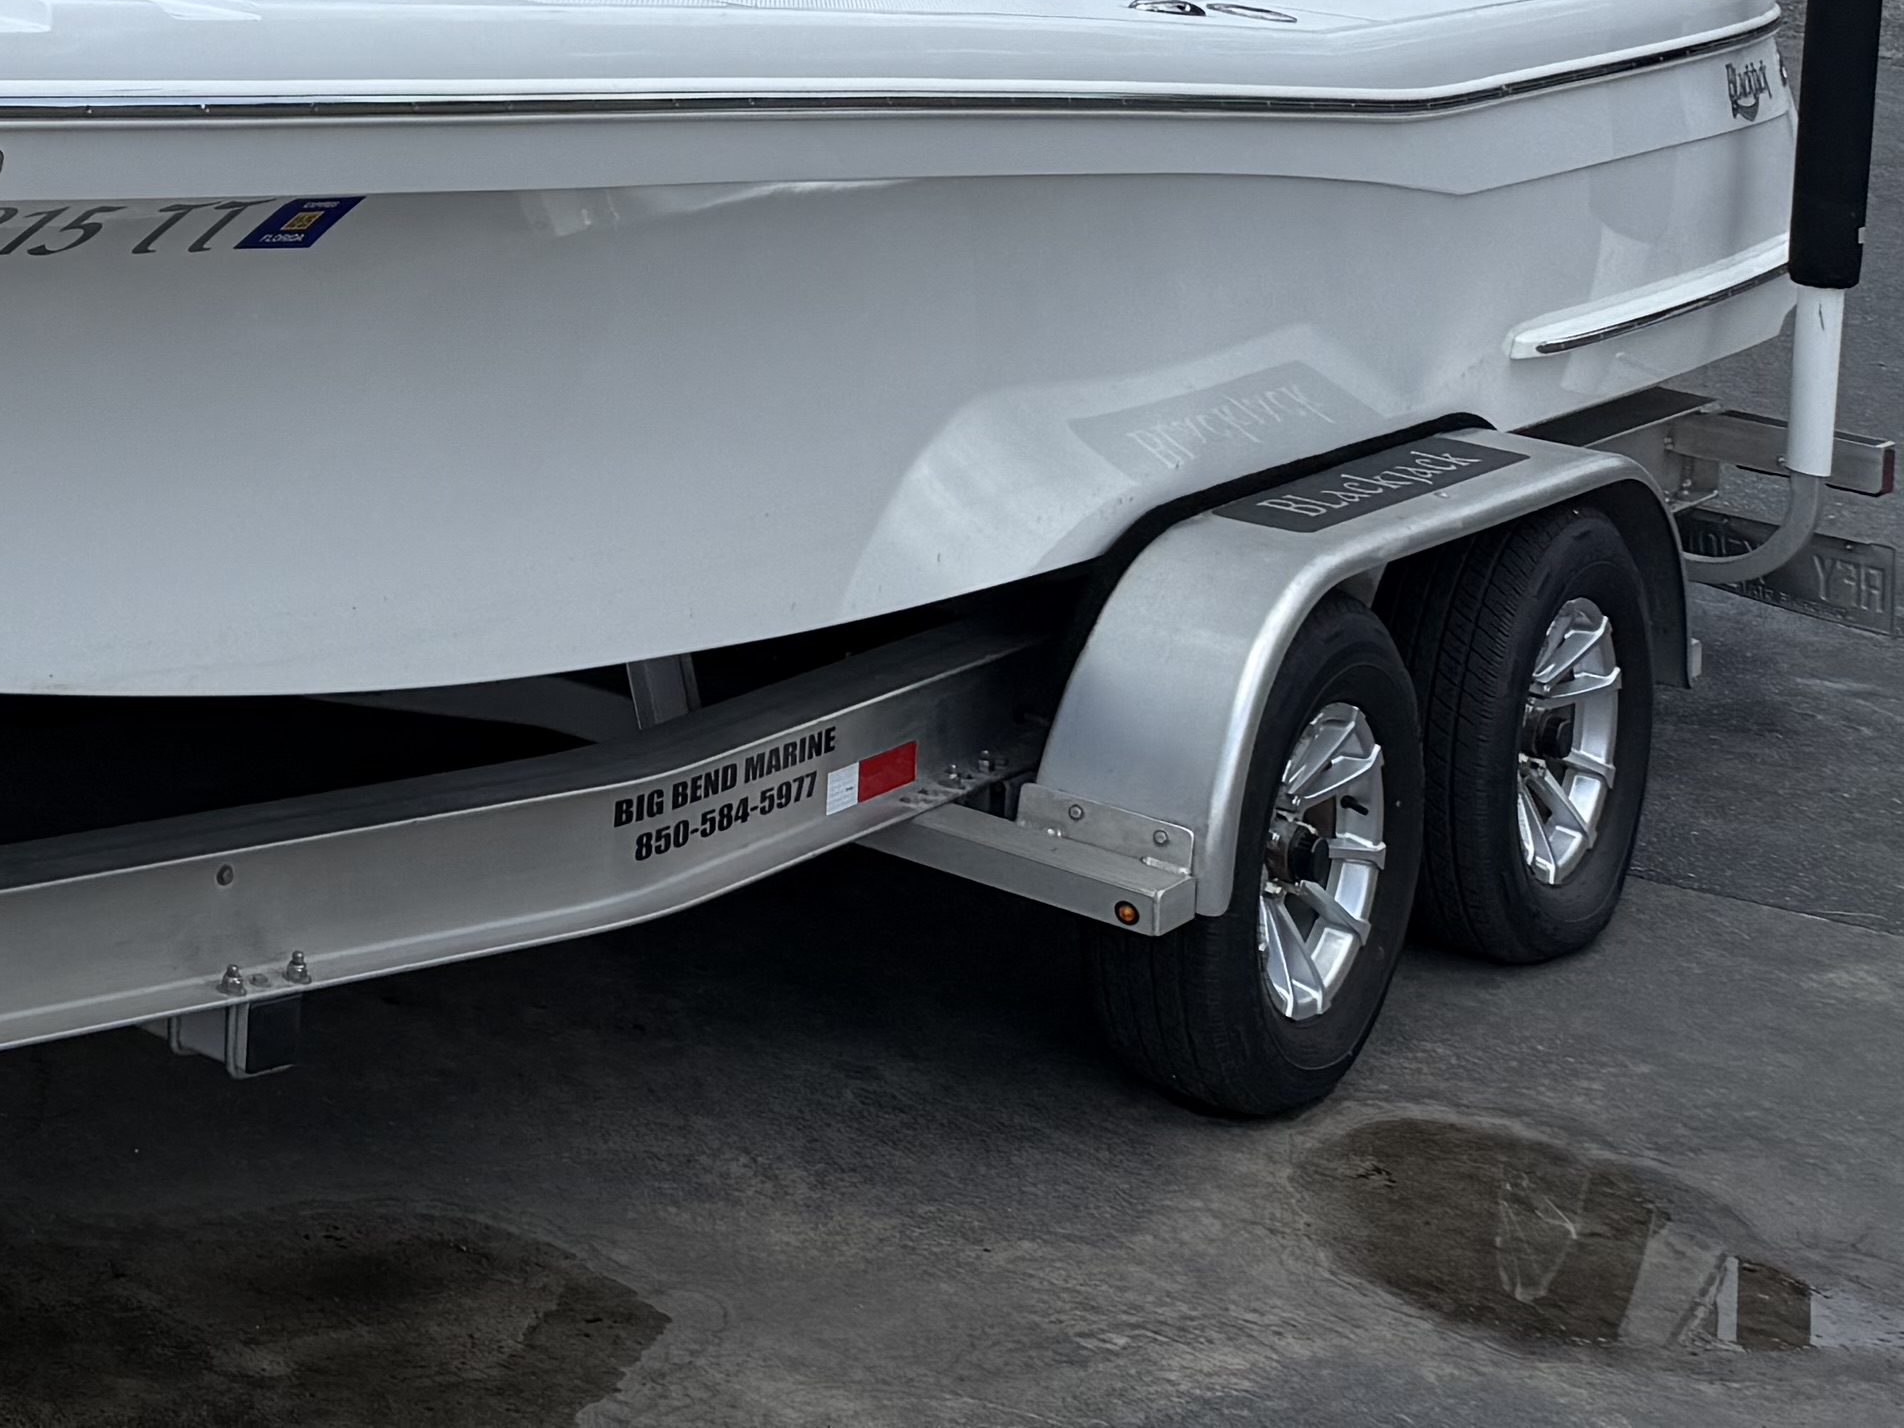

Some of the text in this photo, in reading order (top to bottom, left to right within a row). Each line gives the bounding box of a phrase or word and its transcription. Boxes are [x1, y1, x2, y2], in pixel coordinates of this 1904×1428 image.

[259, 233, 305, 243] FLORIDA
[613, 725, 838, 828] BIG BEND MARINE
[634, 770, 819, 863] 850-584-5977
